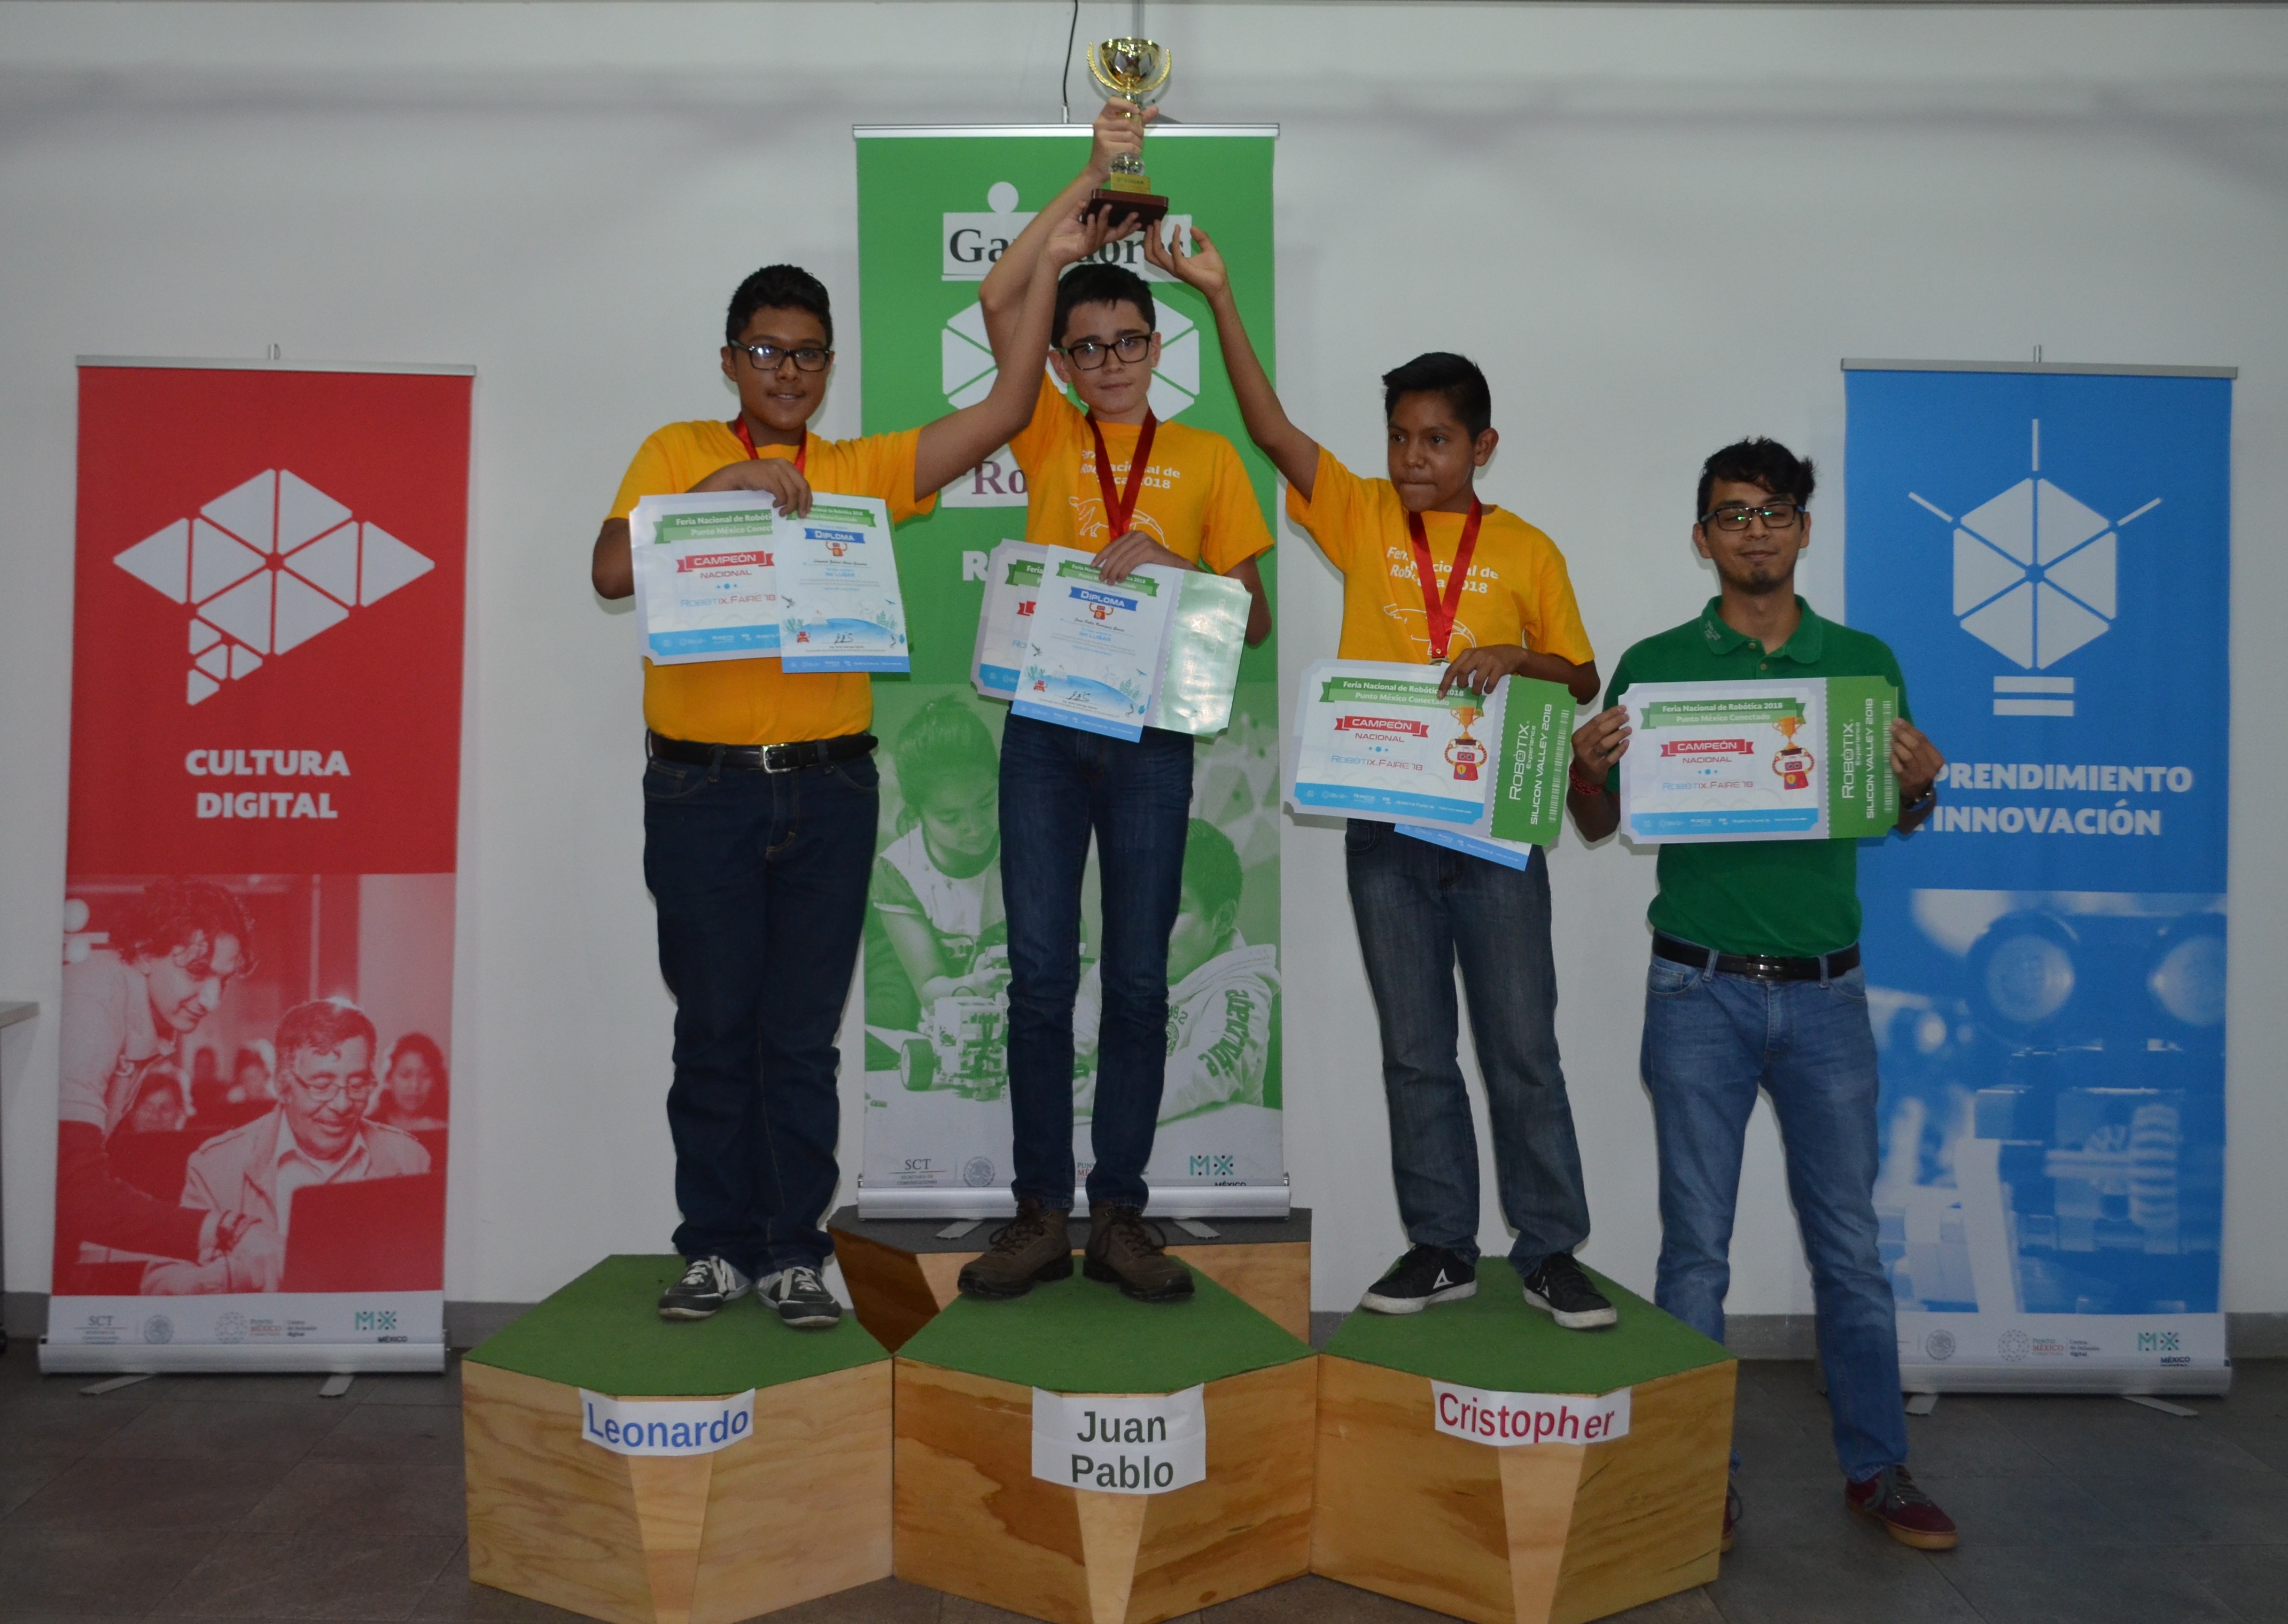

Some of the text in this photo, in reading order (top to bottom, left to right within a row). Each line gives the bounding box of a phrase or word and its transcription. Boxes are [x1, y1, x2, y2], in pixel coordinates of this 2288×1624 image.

[1163, 467, 1180, 478] de
[1140, 476, 1171, 489] 018
[676, 517, 696, 525] Feria
[697, 516, 732, 524] Nacional
[745, 513, 772, 522] Robóti
[717, 526, 745, 534] México
[815, 530, 855, 541] DIPLOMA
[694, 553, 757, 566] CAMPEÓN
[701, 570, 752, 579] NACIONAL
[1026, 565, 1043, 574] Feria
[1480, 567, 1498, 579] de
[1080, 590, 1125, 607] DIPLOMA
[1363, 682, 1396, 691] Nacional
[1409, 686, 1438, 695] Robótic
[1379, 693, 1406, 702] México
[1408, 696, 1450, 706] Conectado
[1683, 704, 1716, 712] Nacional
[1728, 702, 1762, 710] Robótica
[1729, 713, 1771, 721] Conectado
[1352, 718, 1412, 730] CAMPEÓN
[1355, 733, 1404, 742] NACIONAL
[1526, 725, 1536, 770] Experience
[1677, 741, 1737, 751] CAMPEÓN
[185, 749, 351, 776] CULTURA
[1509, 724, 1529, 801] ROBOTIX
[1530, 704, 1552, 825] SILICON VALLEY 2018
[1841, 723, 1854, 798] ROBOTIX
[1865, 698, 1874, 819] SILICON VALLEY 2018
[197, 792, 338, 819] DIGITAL
[1933, 798, 2161, 836] INNOVACIÓN
[905, 1159, 931, 1170] SCT
[1190, 1155, 1234, 1176] MX
[89, 1316, 114, 1326] SCT
[355, 1311, 396, 1330] MX
[2138, 1332, 2178, 1351] MX
[1440, 1393, 1615, 1443] Cristopher
[588, 1402, 749, 1448] Leonardo
[1077, 1411, 1166, 1443] Juan
[1071, 1454, 1173, 1489] Pablo
